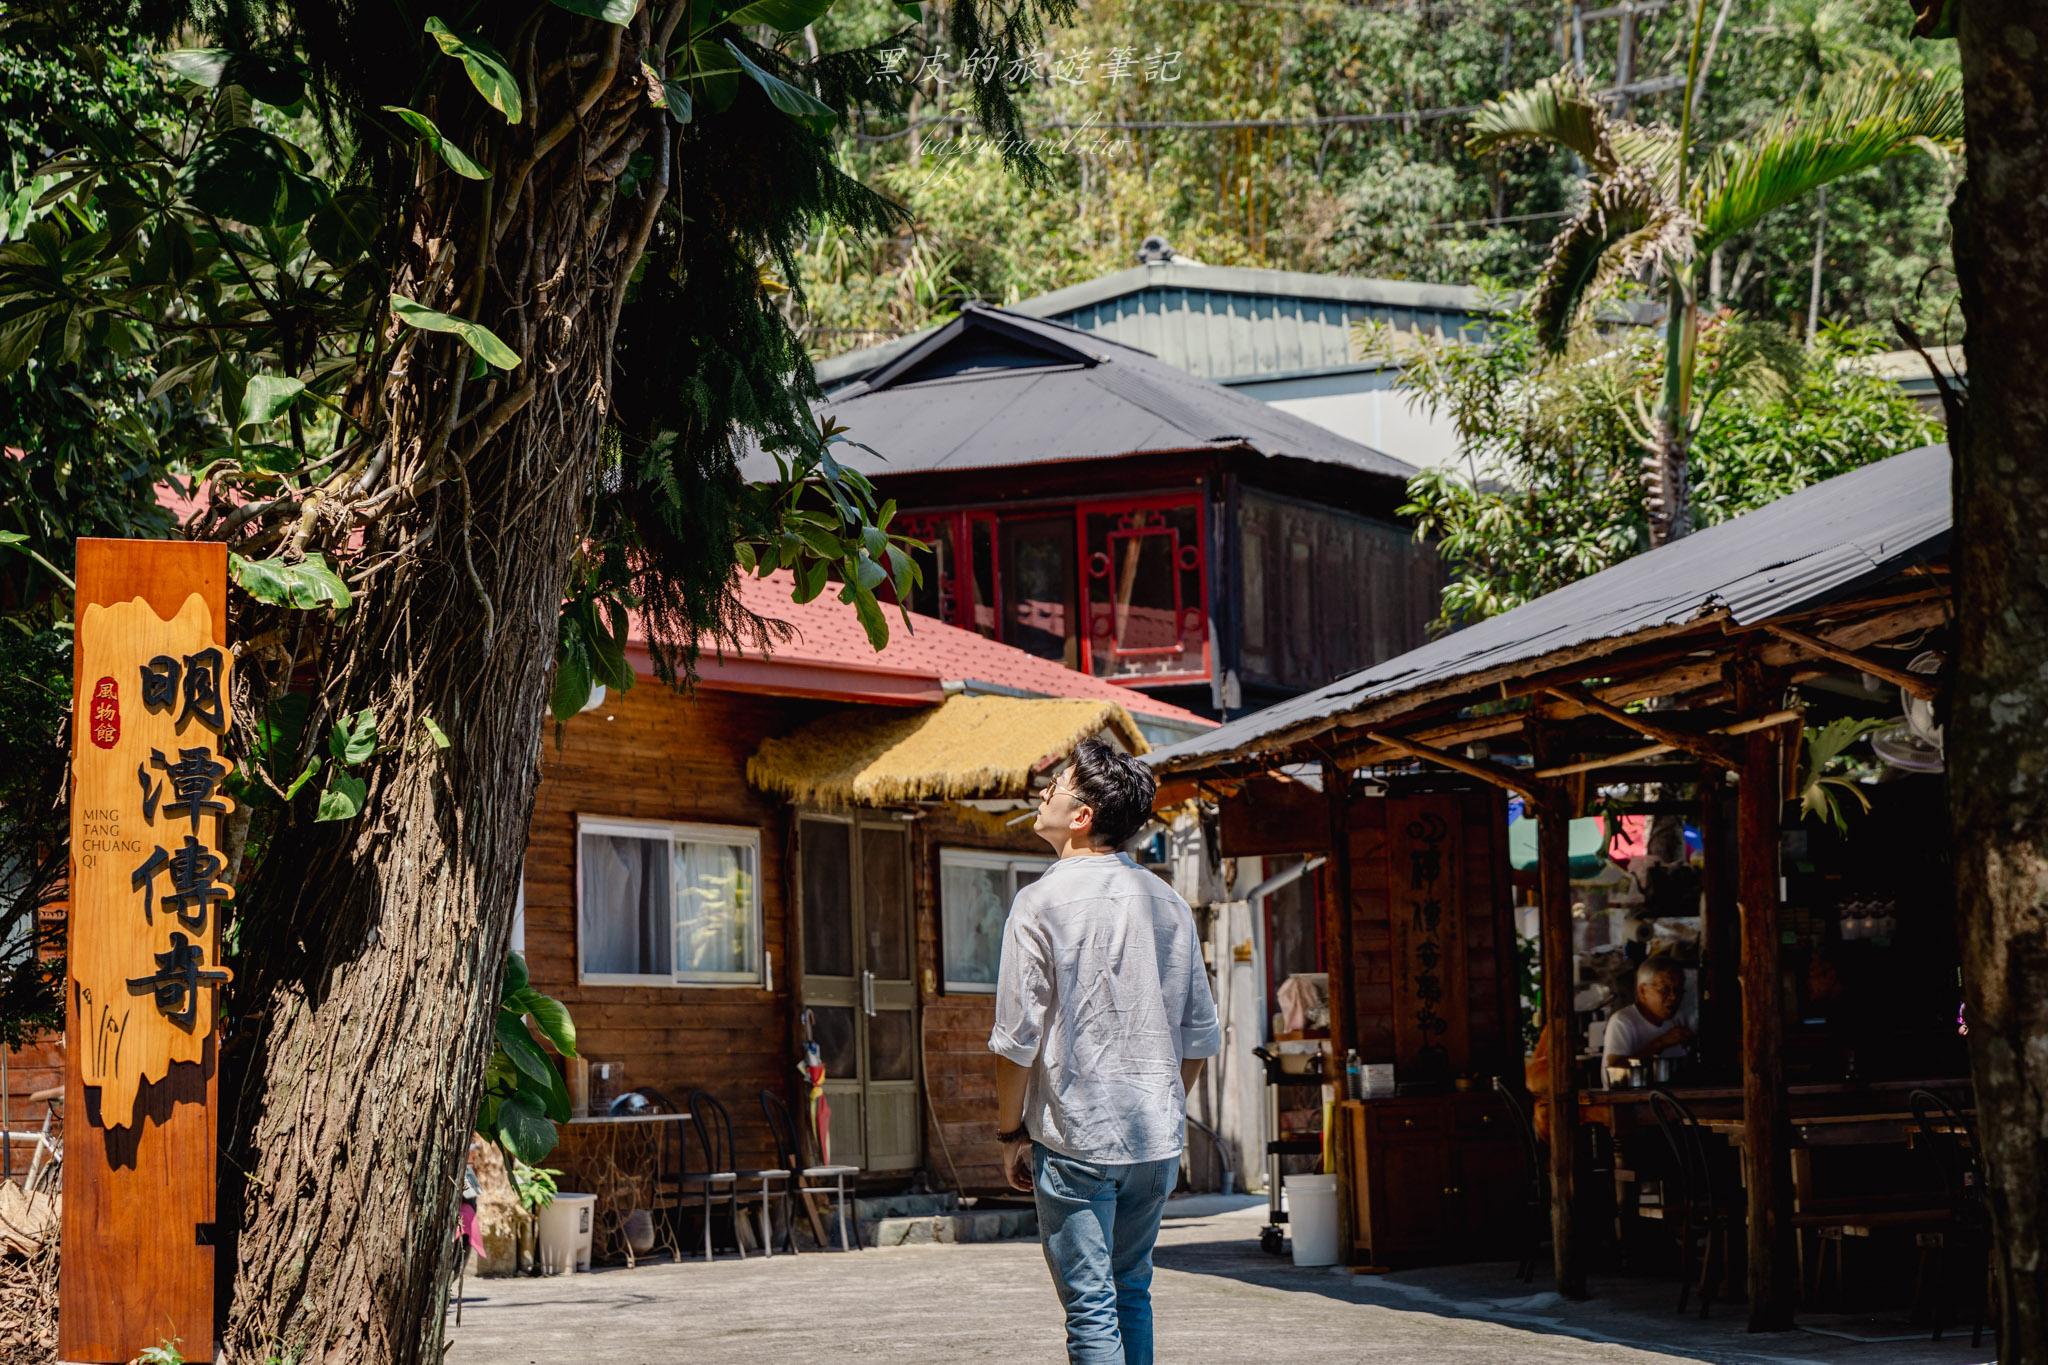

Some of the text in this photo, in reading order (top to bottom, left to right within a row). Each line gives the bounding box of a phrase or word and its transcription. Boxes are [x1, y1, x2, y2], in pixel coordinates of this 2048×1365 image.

[94, 683, 118, 743] 風物館
[83, 810, 119, 822] MING
[83, 825, 119, 837] TANG
[82, 840, 141, 852] CHUANG
[126, 646, 229, 1034] 明潭傳奇
[82, 855, 97, 868] QI
